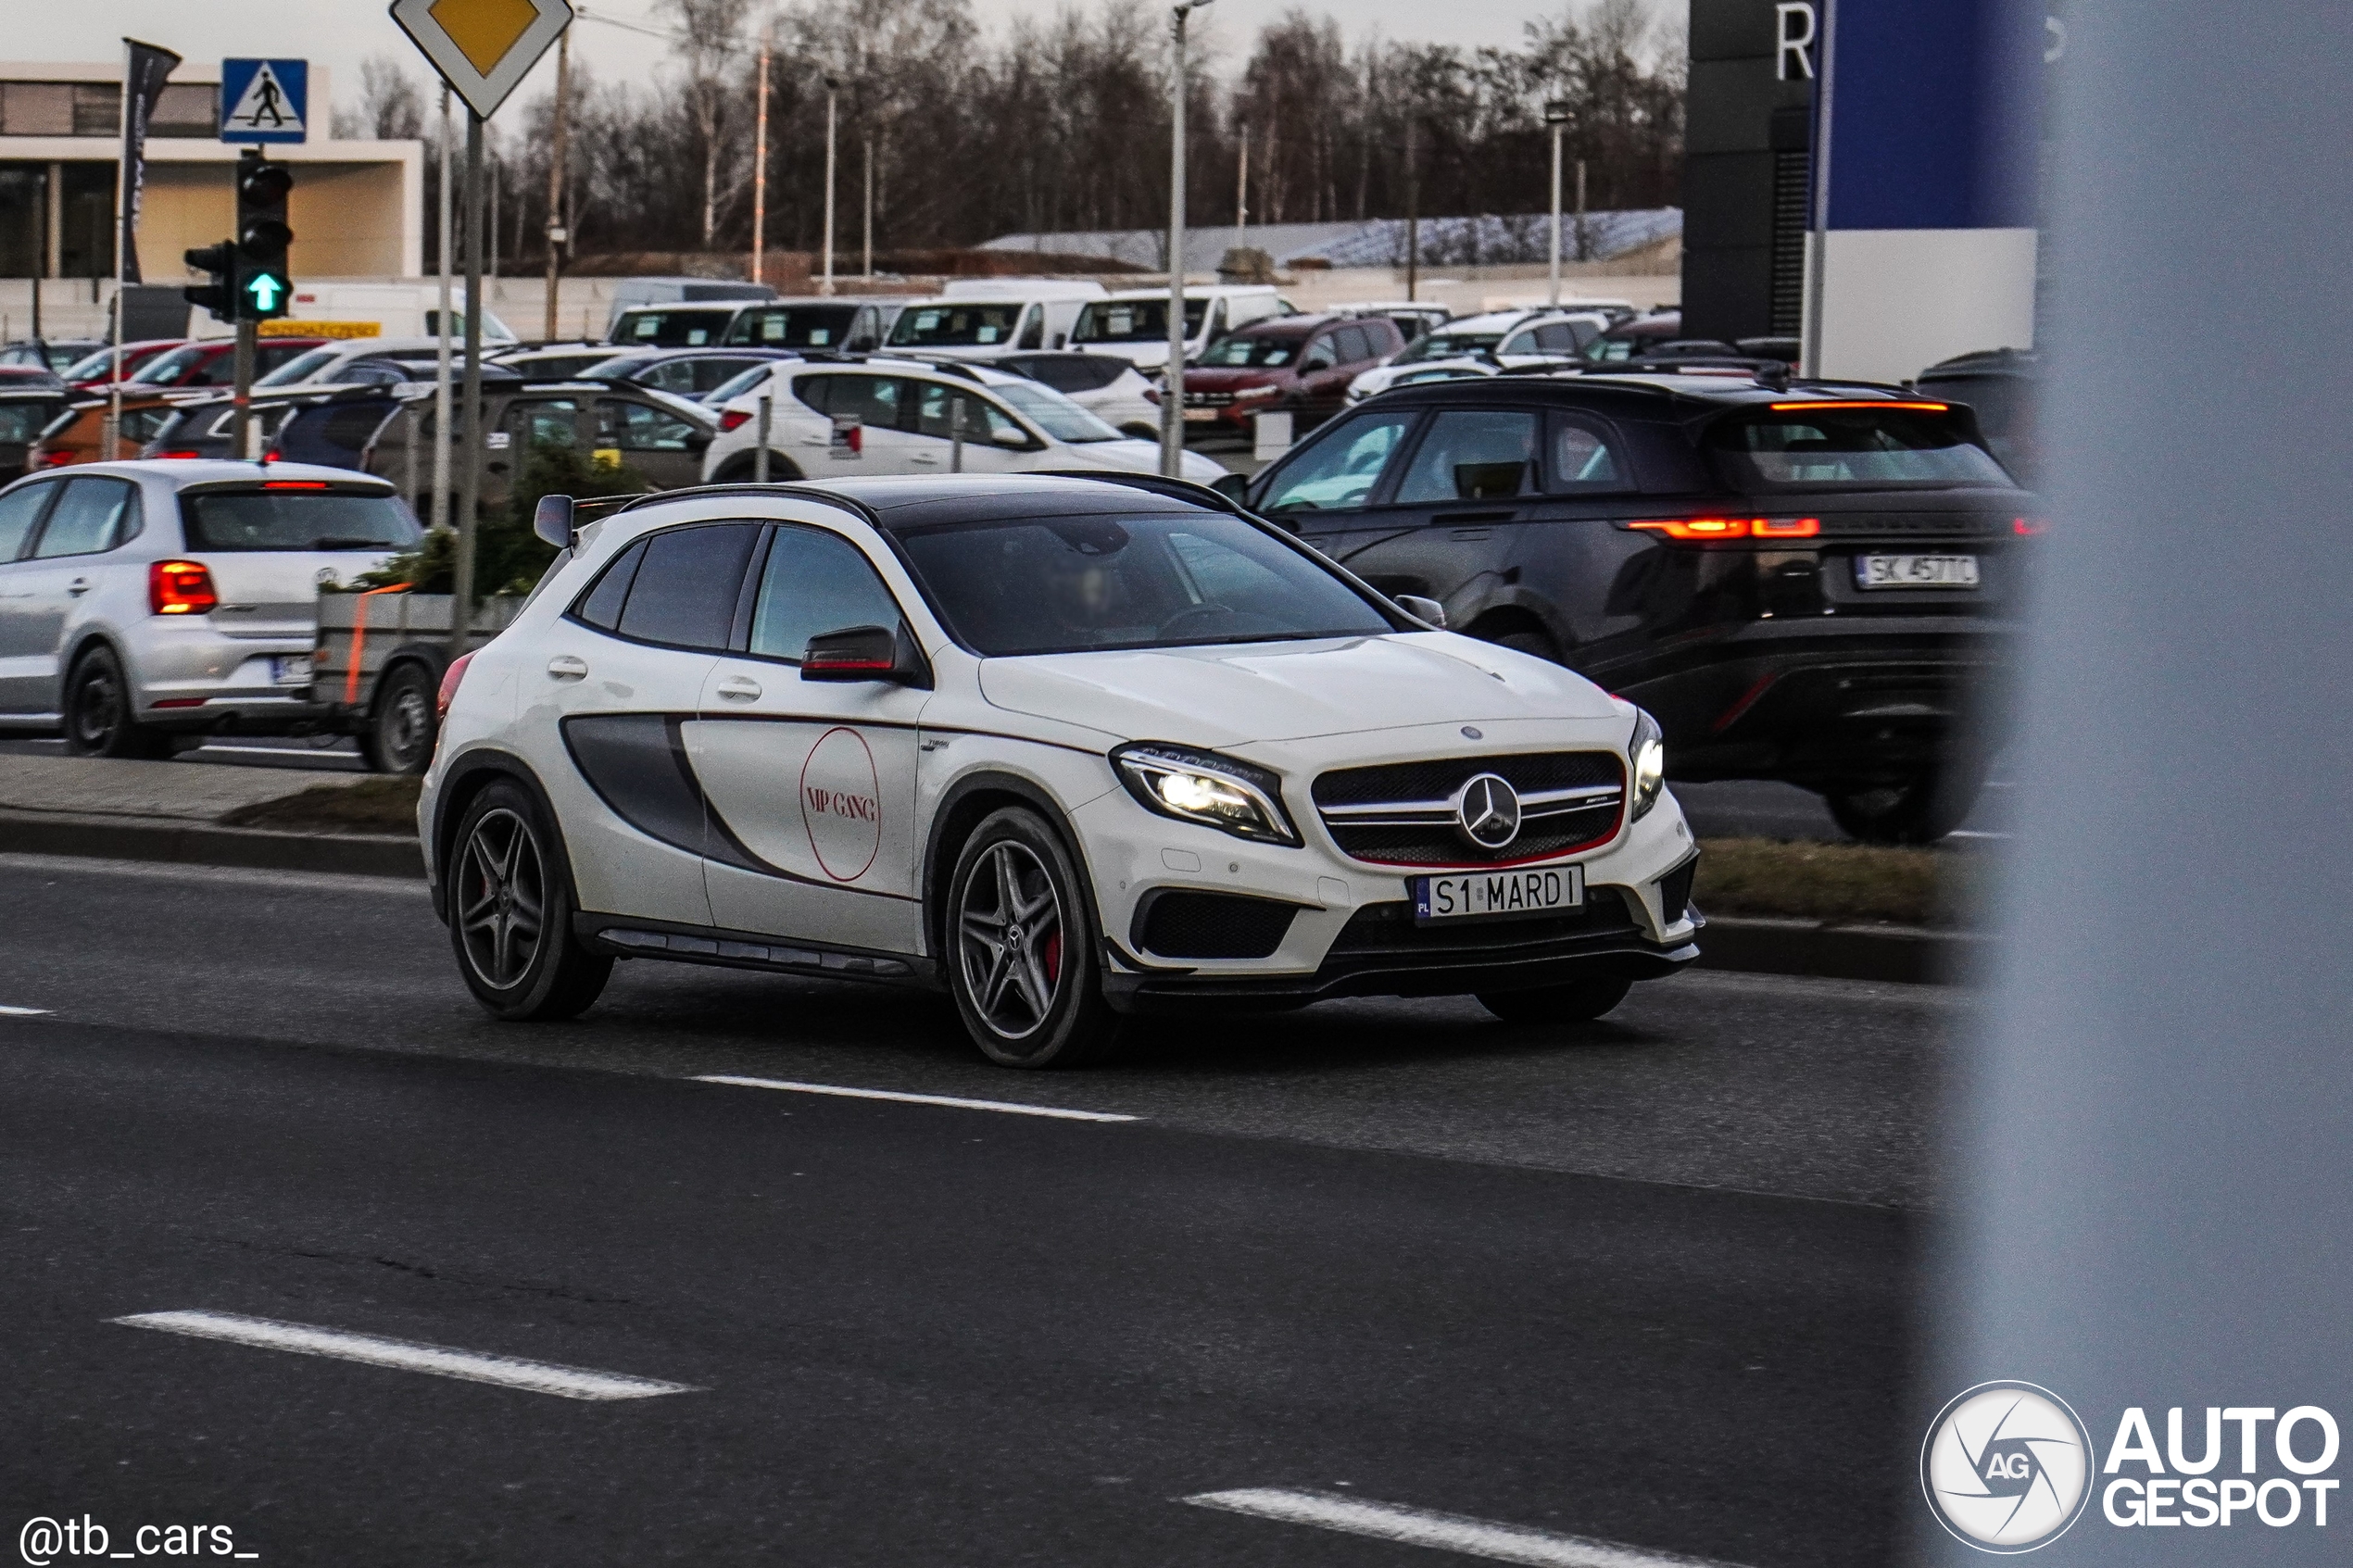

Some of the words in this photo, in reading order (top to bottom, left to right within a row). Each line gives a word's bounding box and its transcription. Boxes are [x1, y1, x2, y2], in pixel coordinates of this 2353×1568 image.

[1871, 558, 1903, 582] SK
[806, 786, 829, 812] VIP
[833, 791, 875, 822] GANG
[1436, 879, 1470, 914] S1
[1487, 870, 1573, 911] MARDI
[1418, 902, 1429, 913] PL
